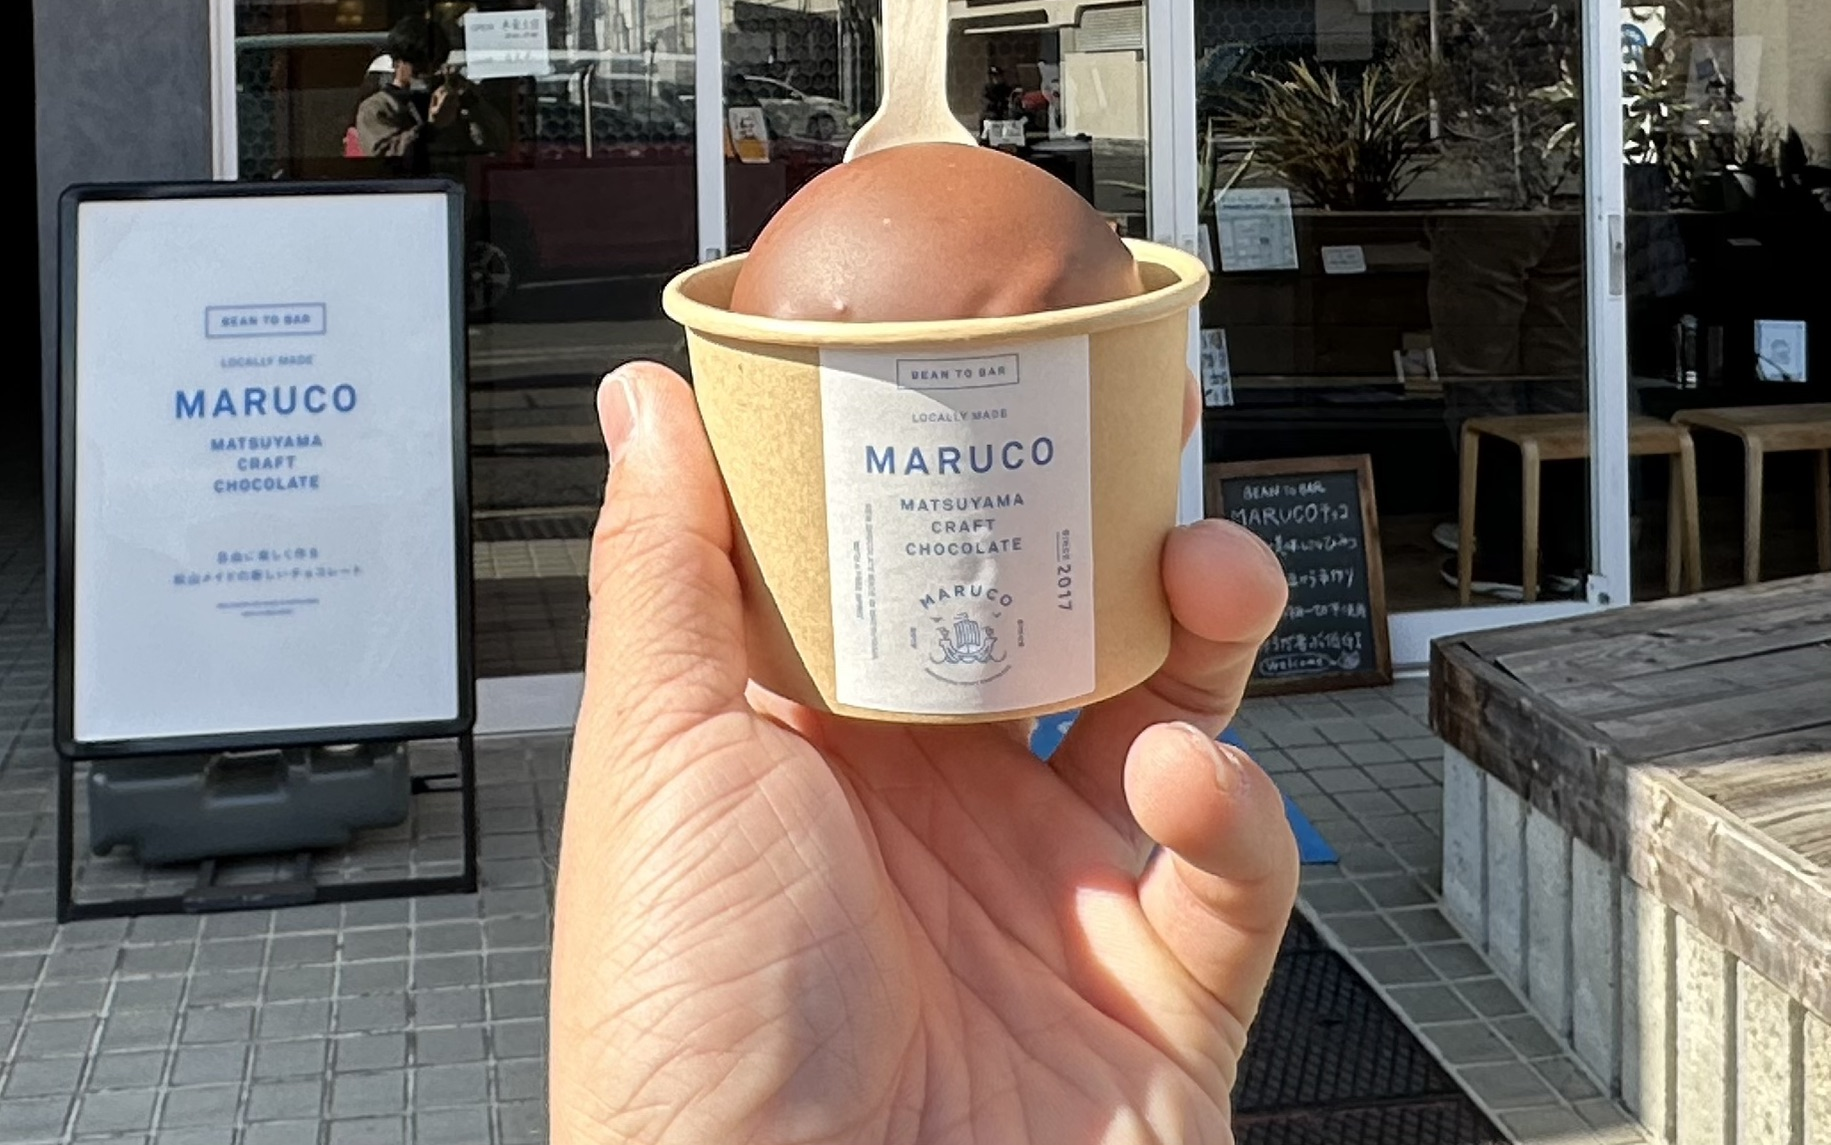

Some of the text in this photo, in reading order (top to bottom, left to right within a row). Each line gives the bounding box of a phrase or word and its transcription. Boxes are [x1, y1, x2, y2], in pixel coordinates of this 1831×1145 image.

[221, 313, 311, 327] BEAN TO BAR
[221, 354, 313, 368] LOCALLY MADE
[911, 366, 1006, 380] BEAN TO BAR
[175, 383, 357, 419] MARUCO
[911, 408, 1008, 423] LOCALLY MADE
[210, 434, 322, 451] MATSUYAMA
[237, 456, 296, 471] CRAFT
[865, 436, 1055, 475] MARUCO
[213, 475, 319, 493] CHOCOLATE
[900, 493, 1025, 512] MATSUYAMA
[931, 518, 997, 534] CRAFT
[905, 537, 1023, 556] CHOCOLATE
[1057, 564, 1073, 611] 2017
[920, 584, 1013, 610] MARUCO
